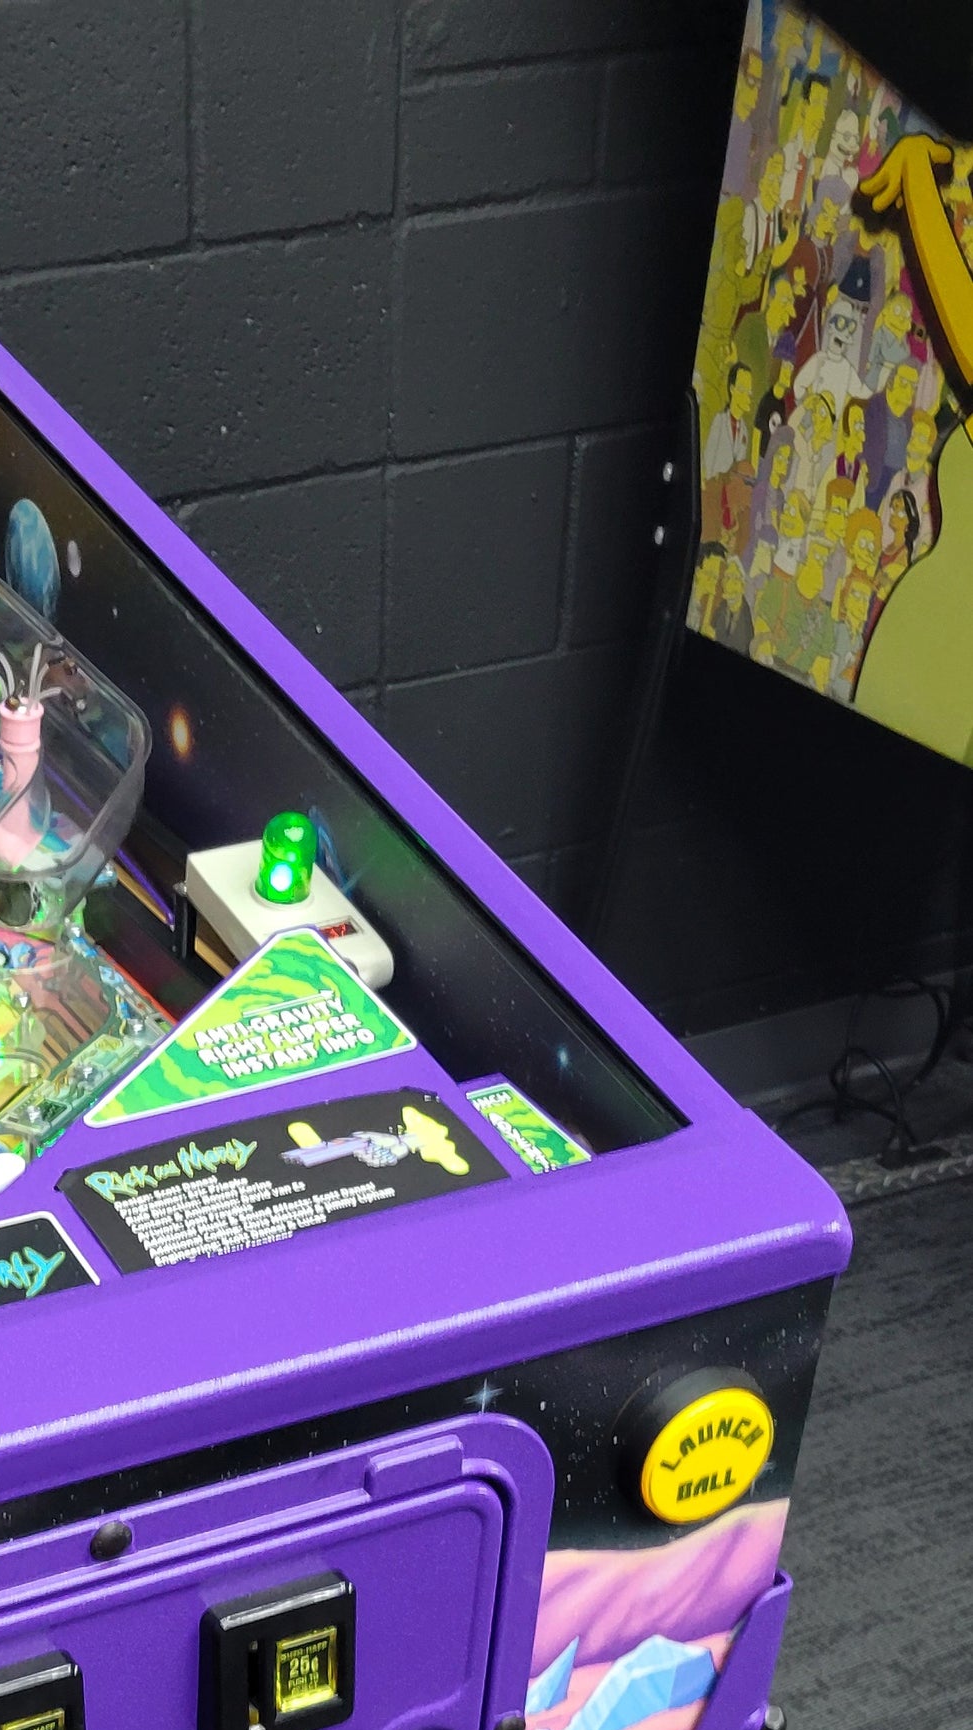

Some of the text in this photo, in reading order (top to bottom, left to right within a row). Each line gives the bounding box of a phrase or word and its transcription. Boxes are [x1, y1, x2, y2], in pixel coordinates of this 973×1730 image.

[197, 1014, 362, 1066] RIGHT FLIPPER
[221, 1028, 375, 1080] INSTANT INFO
[85, 1164, 158, 1202] Rick
[177, 1138, 258, 1178] Morty
[660, 1416, 764, 1472] LAUNCH
[676, 1467, 736, 1503] BALL
